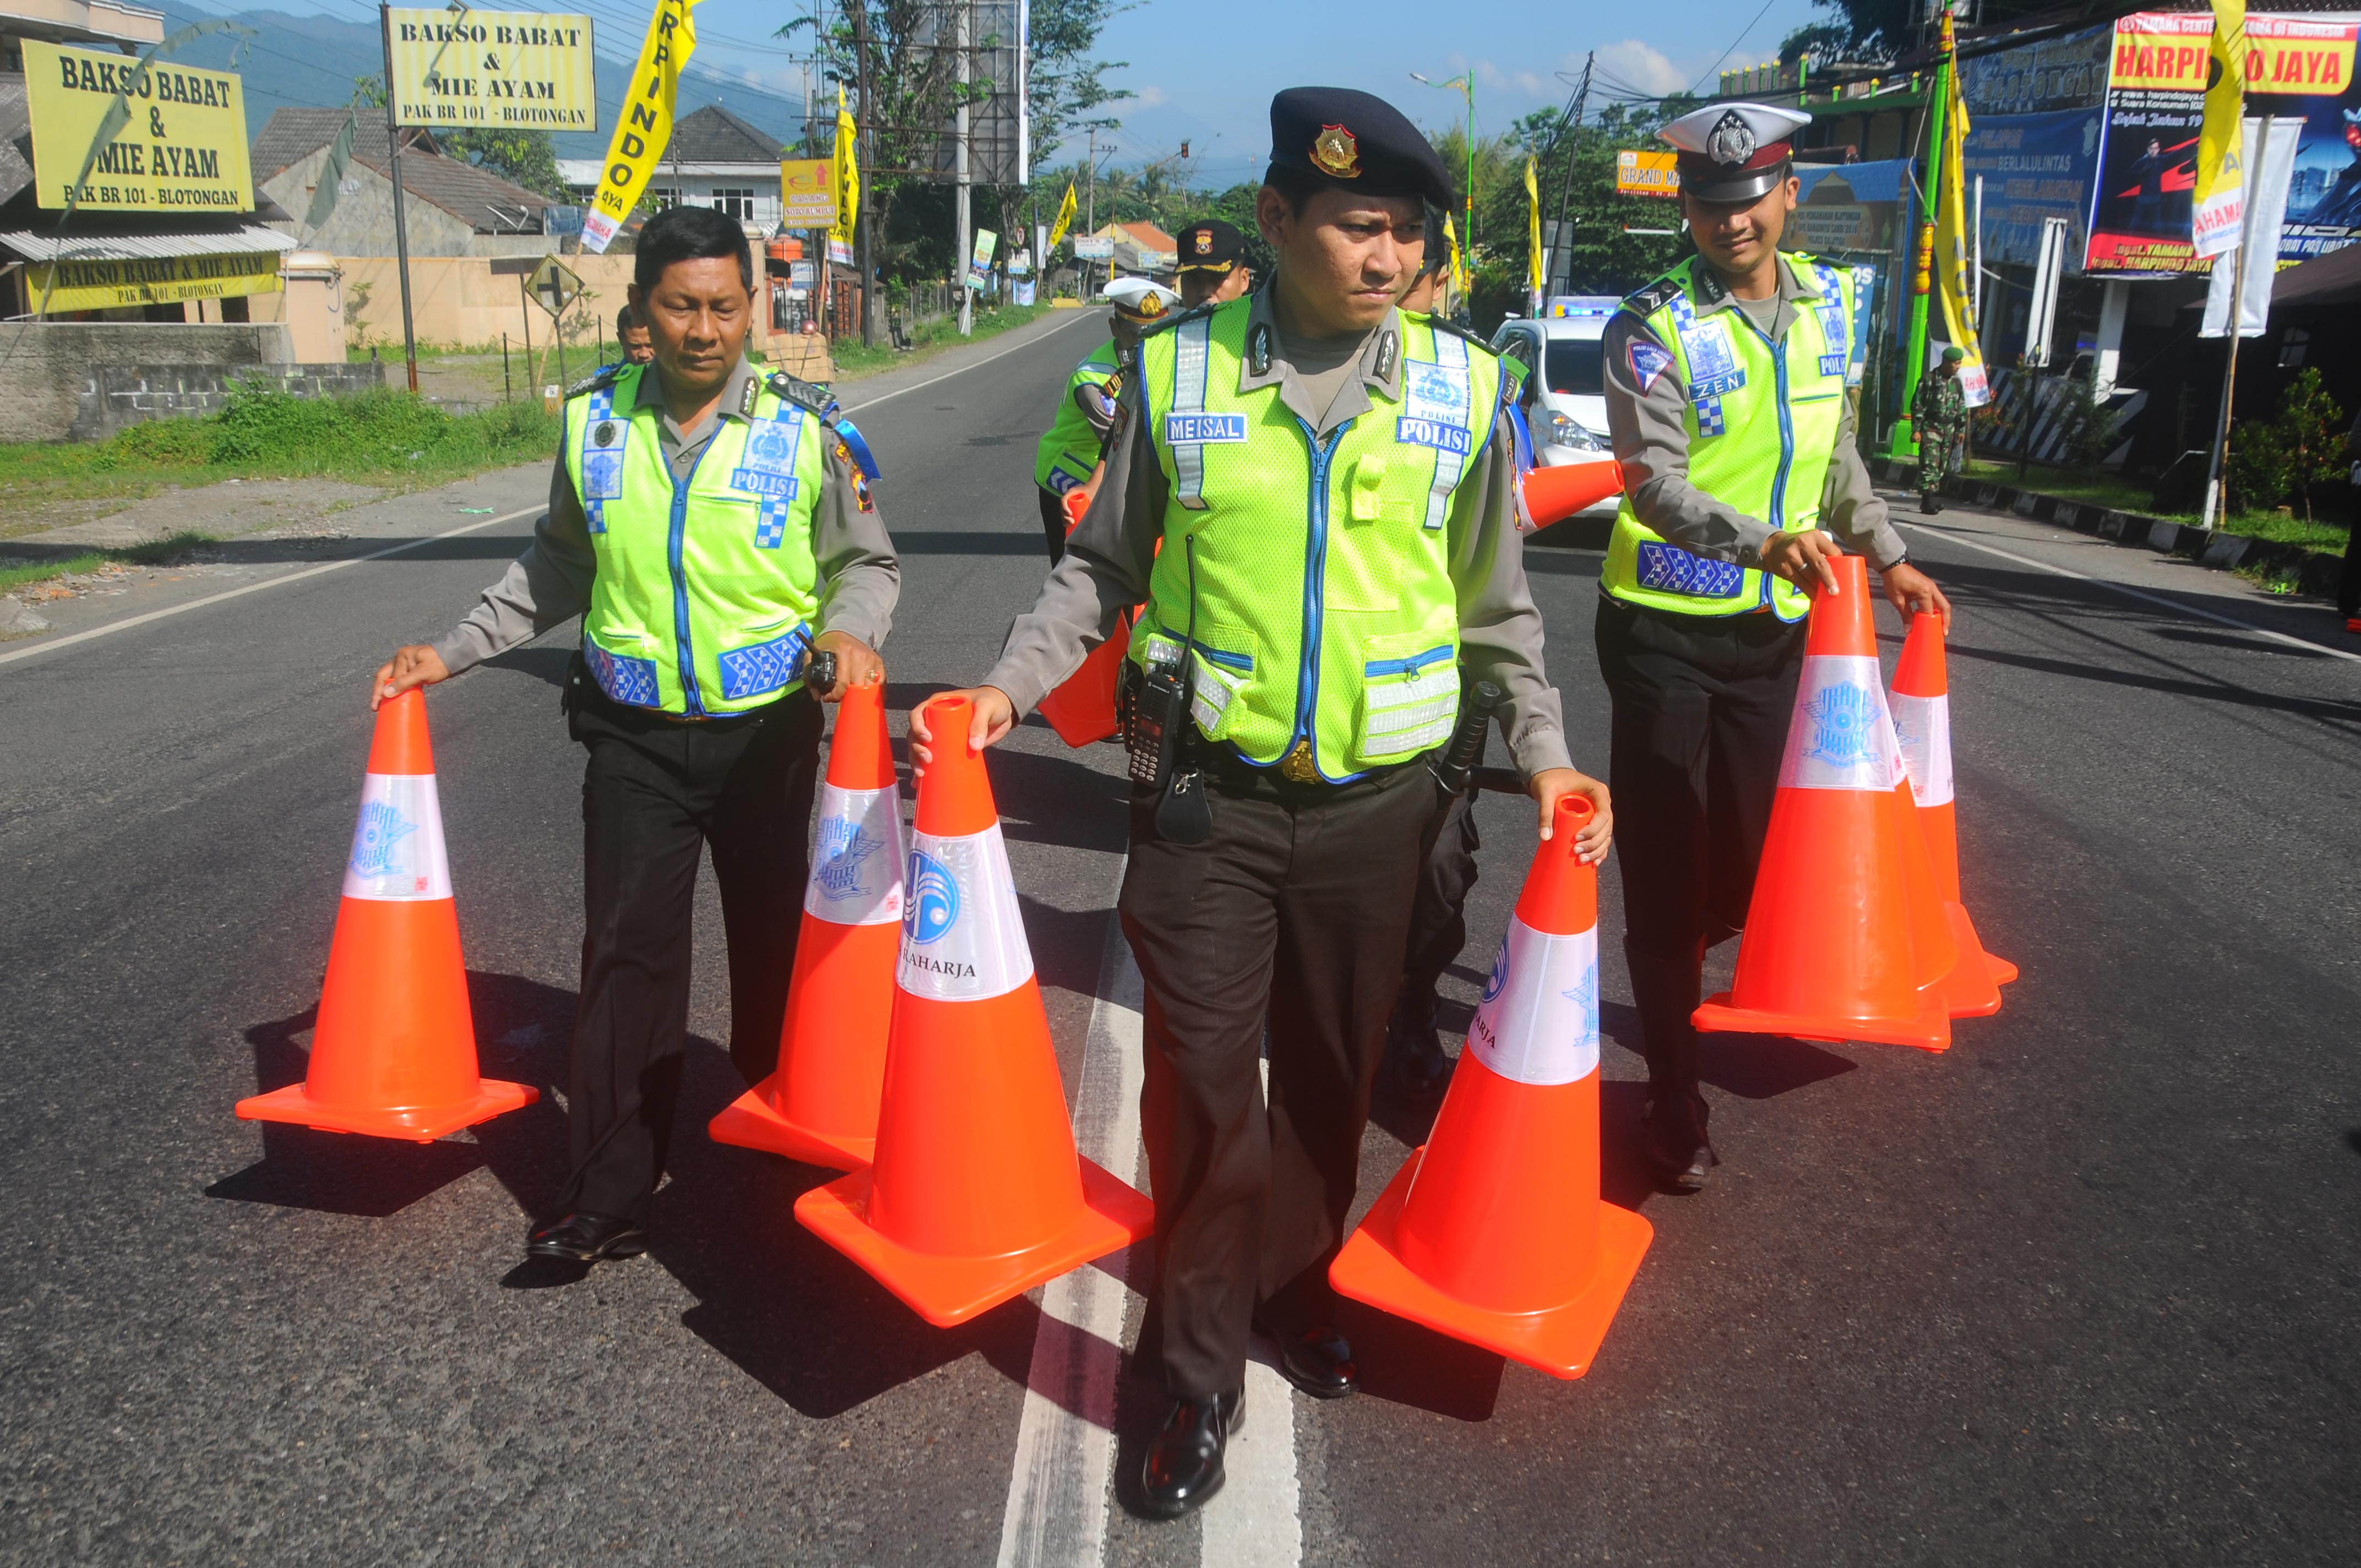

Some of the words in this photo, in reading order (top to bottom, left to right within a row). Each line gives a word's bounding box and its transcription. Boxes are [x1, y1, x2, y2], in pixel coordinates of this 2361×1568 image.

[400, 24, 487, 43] BAKSO
[496, 25, 581, 47] BABAT
[2136, 17, 2179, 33] YAMAHA
[2181, 19, 2214, 34] CENTE
[483, 52, 501, 70] &
[2115, 45, 2265, 81] HARPIO
[2271, 50, 2340, 84] JAYA
[59, 56, 151, 99] BAKSO
[156, 70, 230, 109] BABAT
[431, 78, 477, 96] MIE
[486, 79, 556, 99] AYAM
[609, 0, 683, 187] RPINDO
[403, 104, 432, 119] PAK
[437, 105, 457, 119] BR
[462, 106, 486, 121] 101
[503, 107, 586, 124] BLOTONGAN
[2190, 101, 2204, 111] (02
[150, 105, 167, 139] &
[2188, 115, 2203, 127] 19
[97, 142, 145, 176] MIE
[151, 145, 220, 179] AYAM
[1998, 155, 2072, 172] BERLALULINTAS
[1620, 167, 1662, 184] GRAND
[63, 185, 96, 203] PAK
[100, 186, 121, 203] BR
[124, 188, 146, 204] 101
[157, 188, 238, 205] BLOTONGAN
[602, 190, 623, 212] AYA
[785, 208, 804, 216] SOTO
[806, 206, 835, 216] RUMPUT
[2278, 238, 2303, 252] OBAT
[59, 263, 119, 287] BAKSO
[124, 256, 178, 283] BABAT
[182, 260, 193, 279] &
[197, 258, 225, 277] MIE
[228, 255, 265, 275] AYAM
[118, 288, 136, 303] PAK
[155, 287, 169, 301] 101
[177, 283, 224, 298] BLOTONGAN
[1696, 374, 1739, 398] ZEN
[1421, 410, 1455, 424] POLISI
[1170, 418, 1240, 440] MEISAL
[1400, 419, 1471, 454] POLISI
[733, 471, 797, 497] POLISI
[903, 948, 977, 979] RAHARJA
[1475, 1013, 1495, 1049] ARJA
